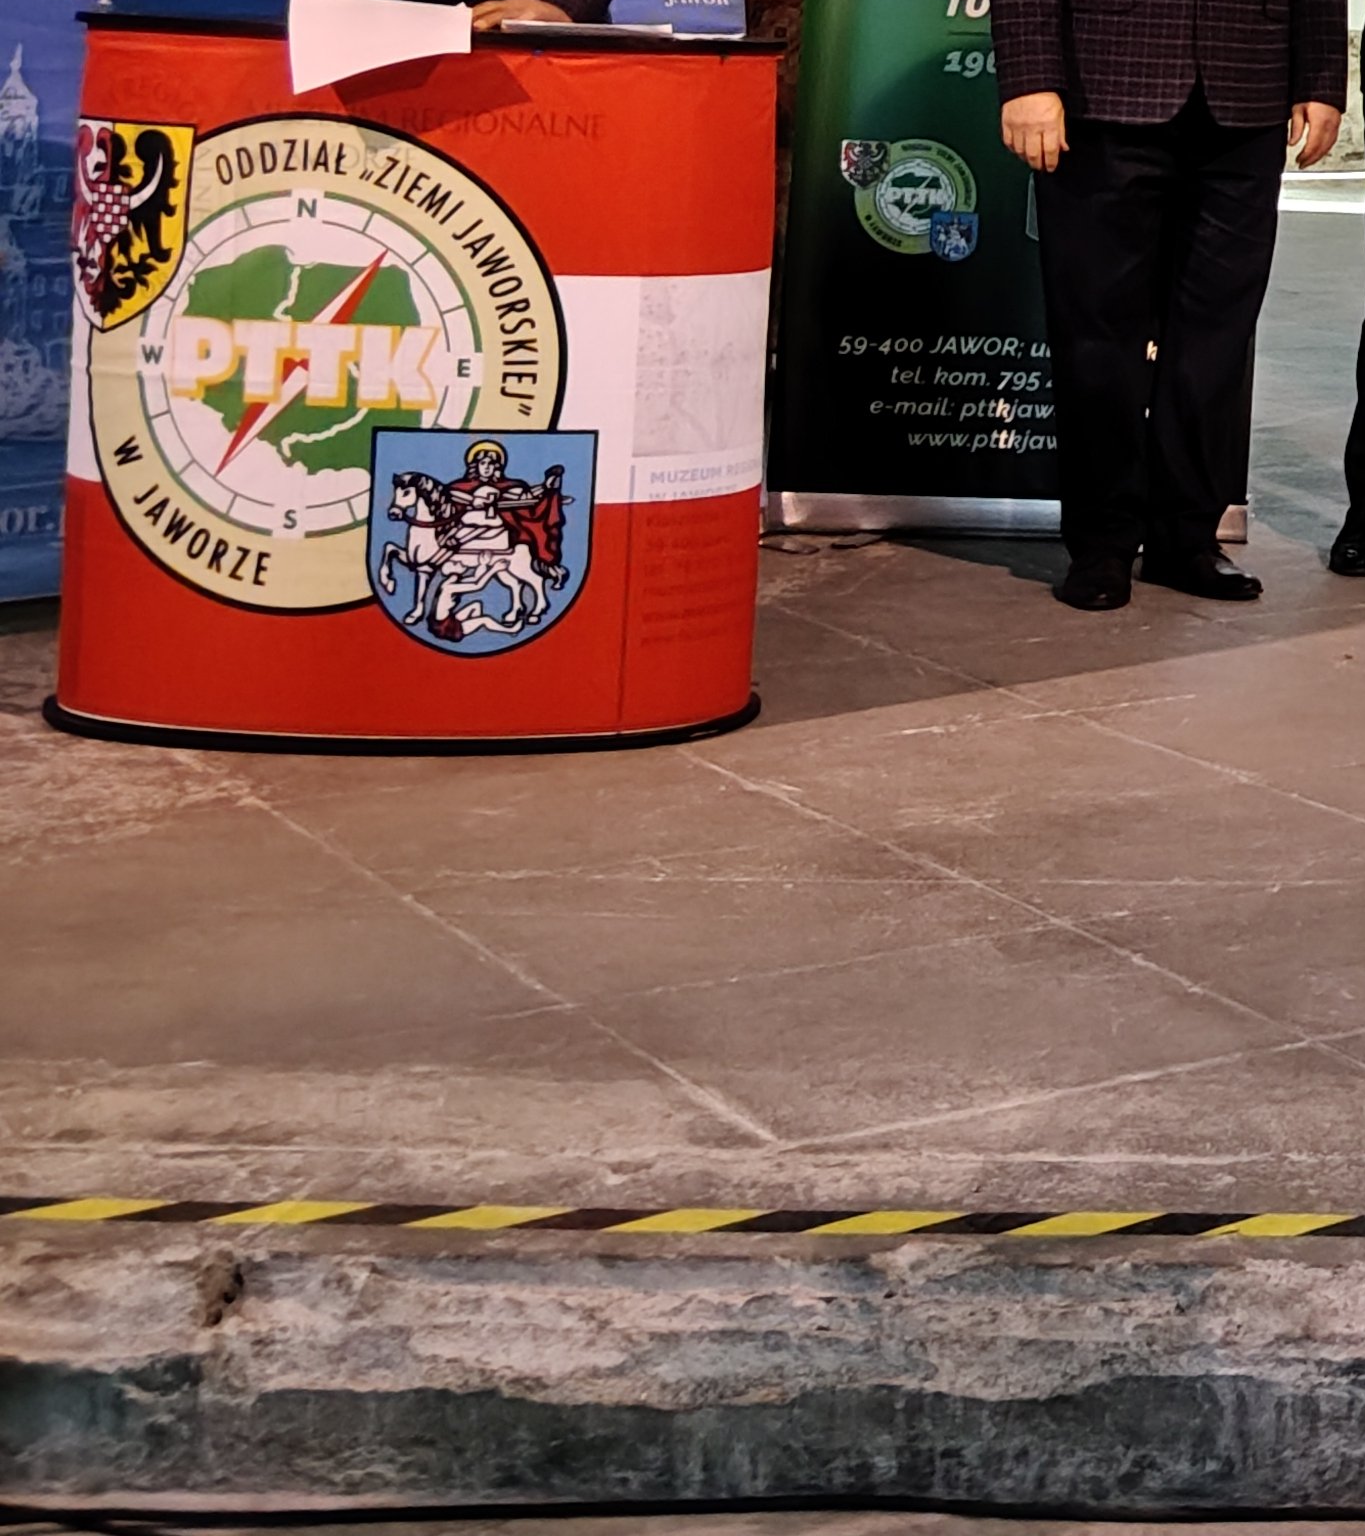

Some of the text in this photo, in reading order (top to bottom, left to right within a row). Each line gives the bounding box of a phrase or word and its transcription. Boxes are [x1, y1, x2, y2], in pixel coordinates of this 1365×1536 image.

[216, 136, 348, 186] ODDZIAŁ
[297, 197, 317, 219] N
[141, 344, 164, 366] W
[838, 335, 924, 355] 59-400
[929, 336, 1026, 360] JAWOR;
[171, 315, 442, 410] PTTK
[456, 358, 472, 378] E
[891, 366, 1042, 392] tel. kom. 795
[869, 396, 1057, 423] e-mail: pttkjaw
[908, 429, 1058, 453] www.pttkjaw
[113, 435, 273, 587] W JAWORZE
[282, 508, 298, 530] S
